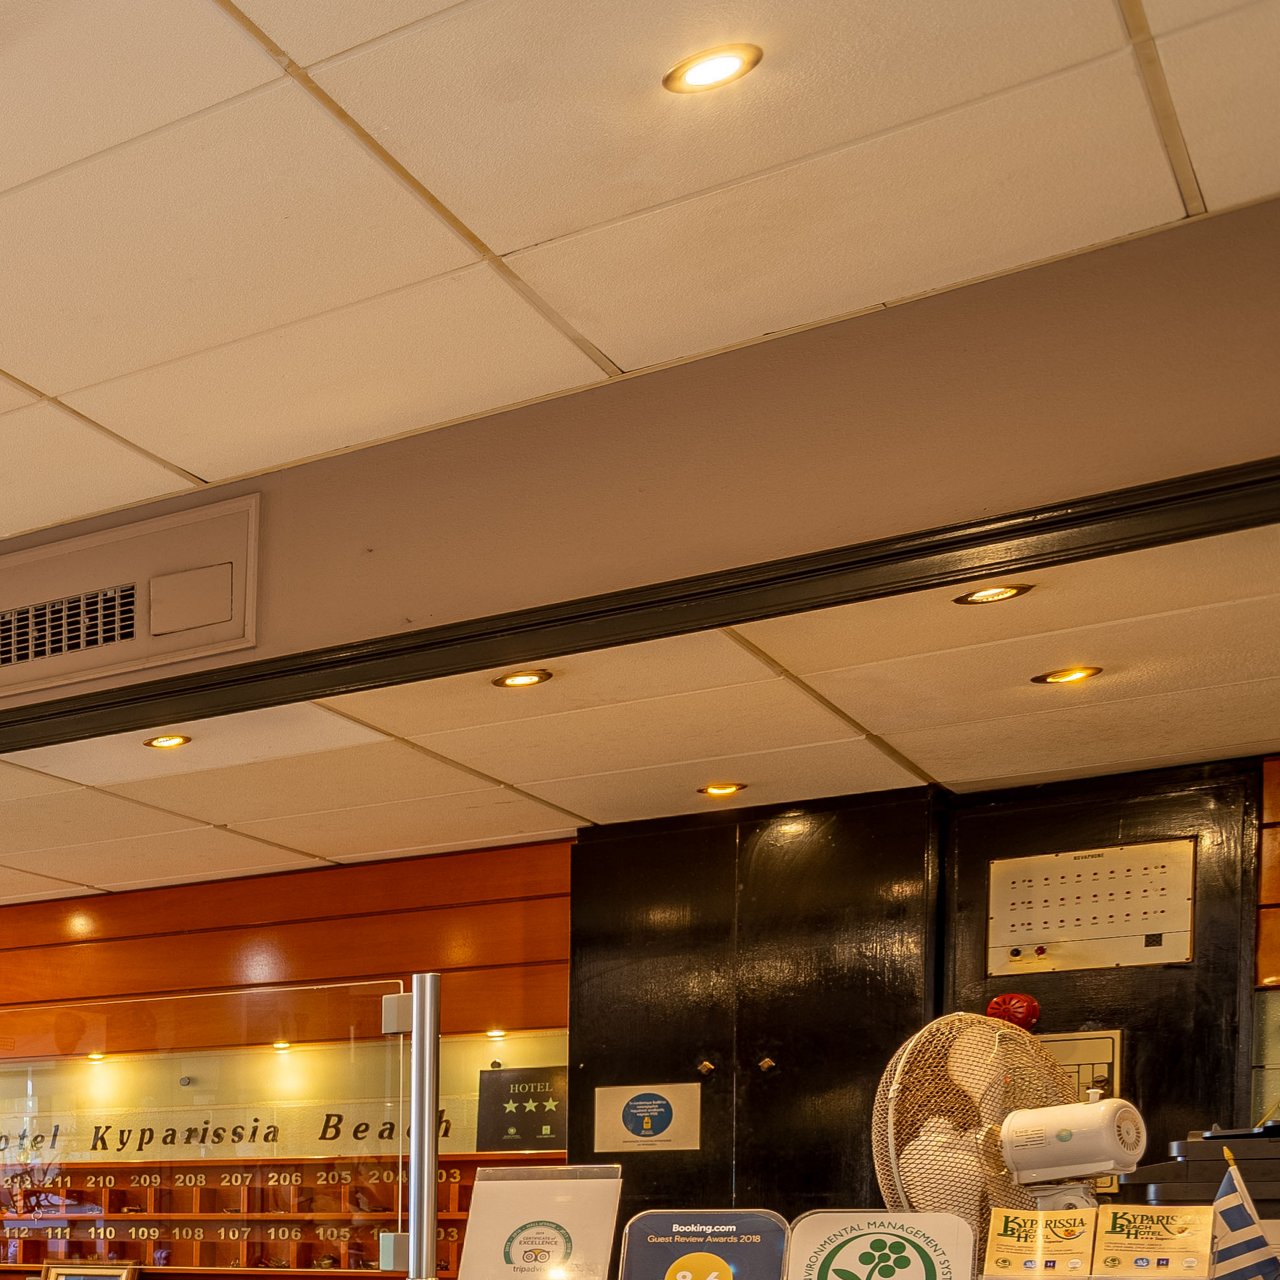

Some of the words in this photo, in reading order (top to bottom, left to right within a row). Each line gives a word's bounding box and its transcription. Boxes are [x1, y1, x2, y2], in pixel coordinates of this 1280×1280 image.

[510, 1083, 554, 1093] HOTEL
[90, 1117, 280, 1152] Kyparissia
[44, 1176, 71, 1188] 211
[86, 1175, 115, 1188] 210
[130, 1174, 161, 1187] 209
[174, 1174, 206, 1187] 208
[220, 1173, 253, 1186] 207
[267, 1172, 302, 1185] 206
[316, 1171, 352, 1184] 205
[368, 1170, 408, 1183] 204
[438, 1169, 461, 1182] 03
[3, 1227, 29, 1238] 112
[45, 1228, 71, 1239] 111
[88, 1228, 115, 1239] 110
[128, 1228, 159, 1240] 109
[172, 1227, 204, 1240] 108
[218, 1228, 251, 1240] 107
[267, 1227, 302, 1240] 106
[316, 1227, 350, 1240] 105
[437, 1228, 459, 1240] 03
[672, 1223, 737, 1233] Booking.com
[647, 1235, 673, 1243] Guest
[674, 1235, 704, 1243] Review
[705, 1235, 738, 1243] Awards
[739, 1234, 761, 1243] 2018
[867, 1221, 946, 1257] MANAGEMENT
